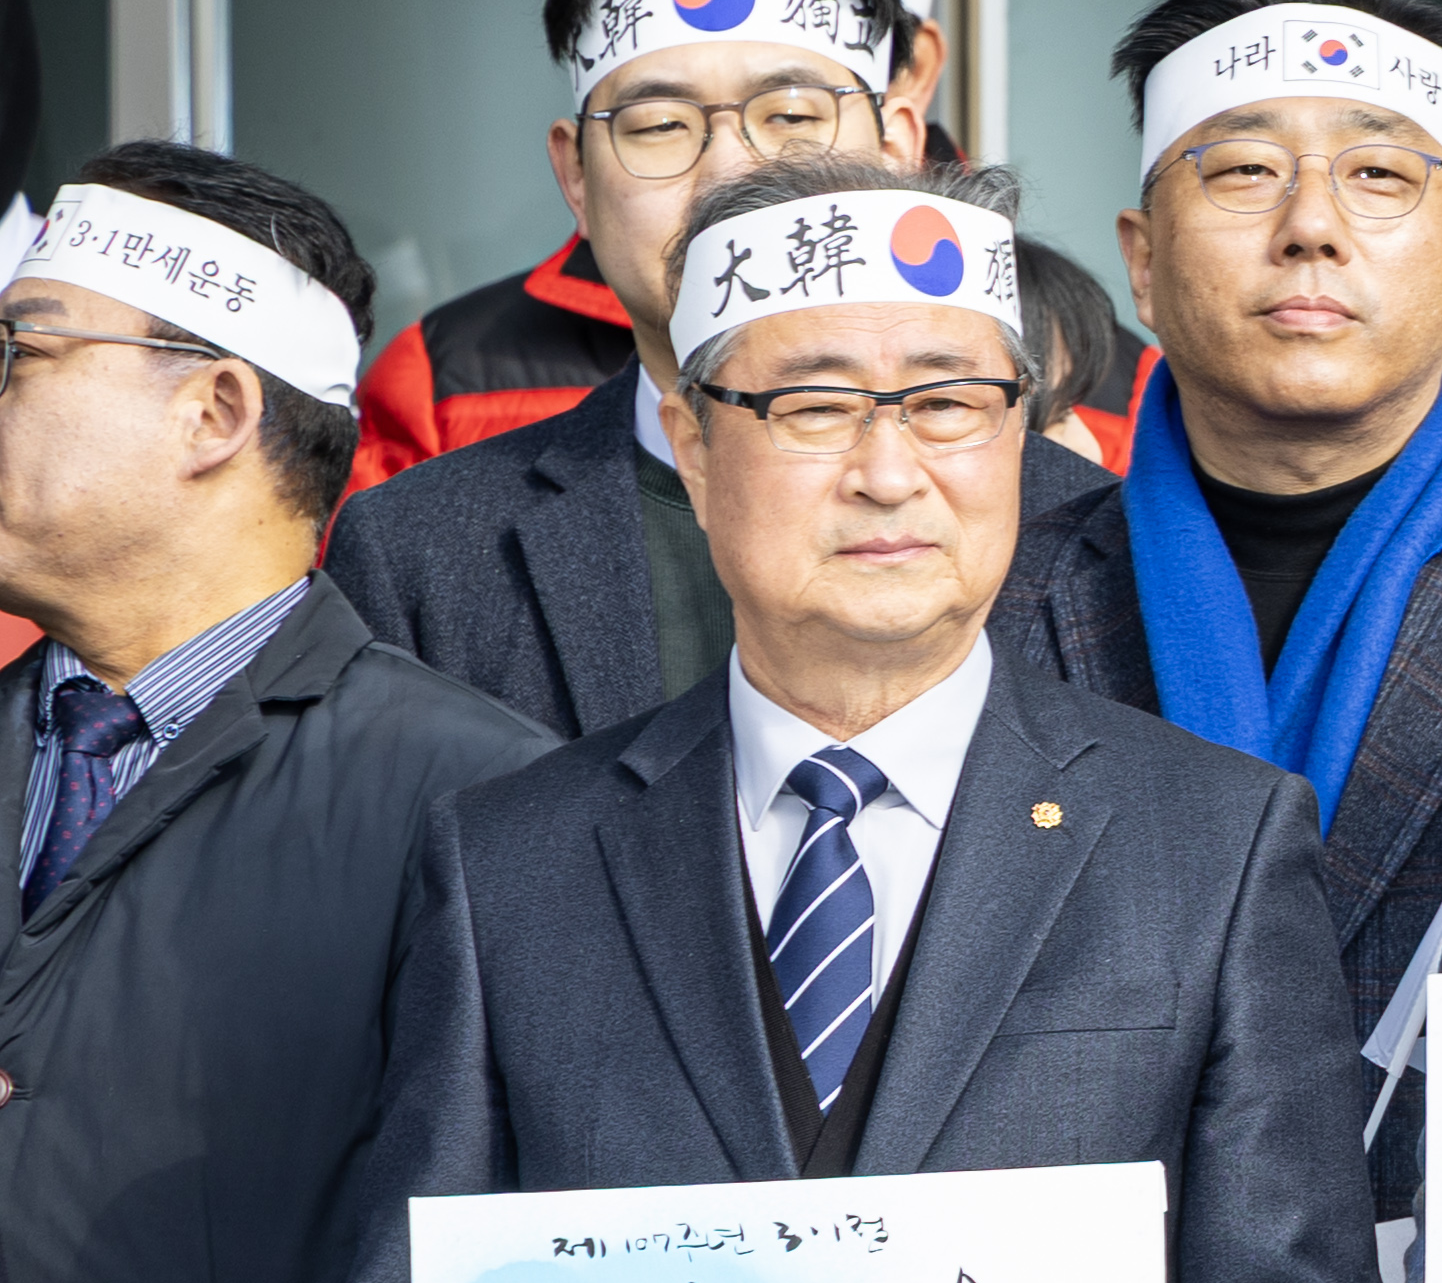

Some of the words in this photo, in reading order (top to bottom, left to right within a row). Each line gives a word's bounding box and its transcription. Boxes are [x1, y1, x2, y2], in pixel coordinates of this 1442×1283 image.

[1214, 35, 1277, 80] 나라
[1390, 56, 1442, 105] 사랑
[710, 203, 867, 319] 大韓
